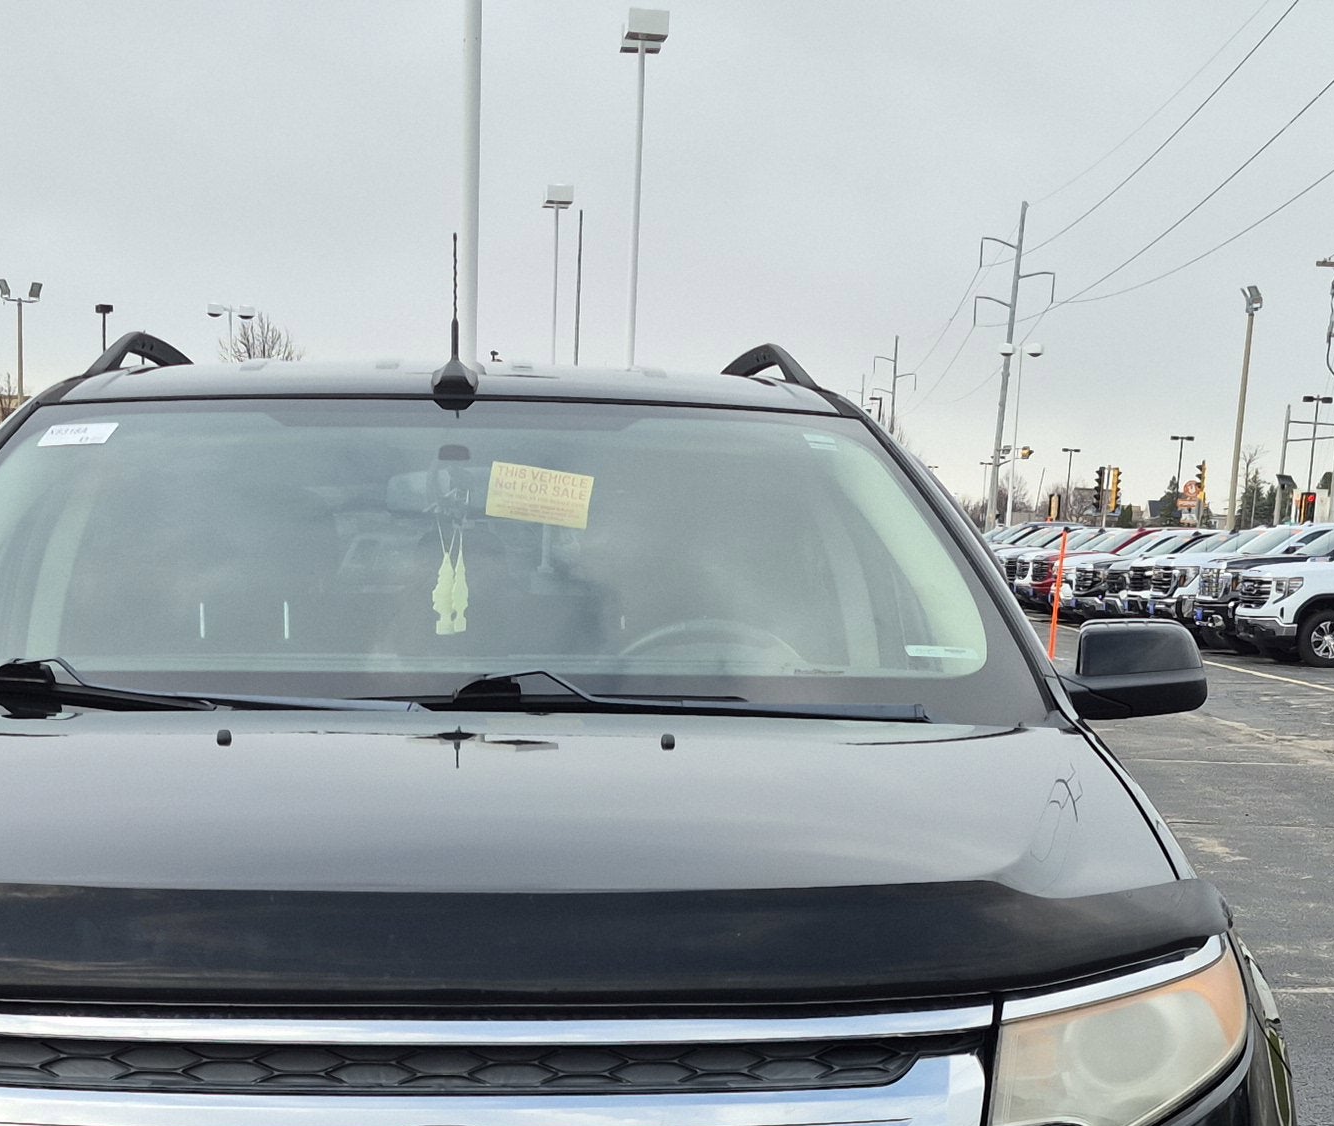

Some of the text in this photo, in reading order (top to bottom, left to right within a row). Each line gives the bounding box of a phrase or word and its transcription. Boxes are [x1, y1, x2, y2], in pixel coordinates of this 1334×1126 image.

[498, 466, 589, 489] THIS VEHICLE
[495, 478, 588, 501] Not FOR SALE
